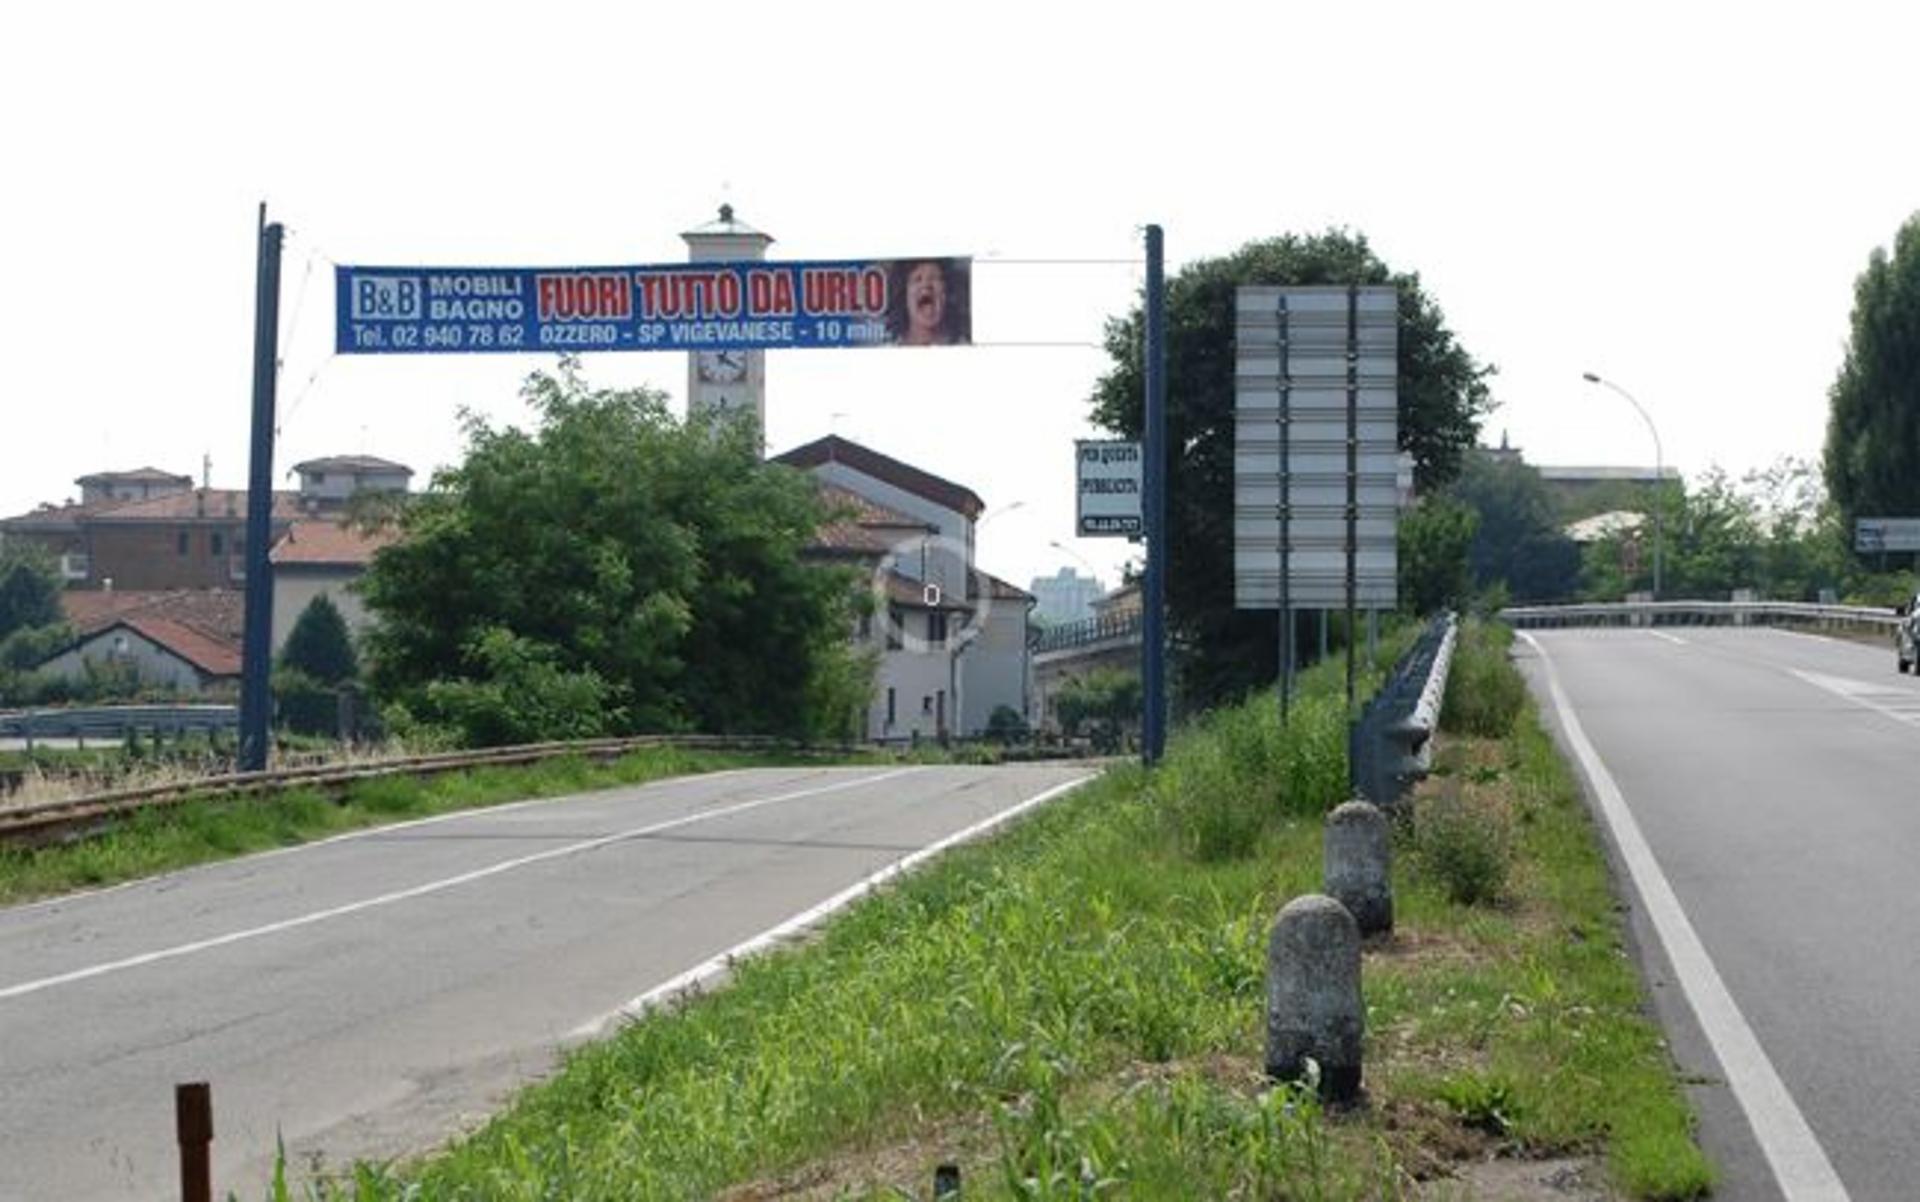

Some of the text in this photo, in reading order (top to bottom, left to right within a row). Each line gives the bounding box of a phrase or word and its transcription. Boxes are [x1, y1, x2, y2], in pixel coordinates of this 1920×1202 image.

[357, 278, 417, 316] B&B
[429, 276, 523, 296] MOBILI
[537, 265, 887, 321] FUORI TUTTO DA URLO
[430, 300, 524, 320] BAGNO
[353, 325, 386, 346] Tel.
[392, 325, 418, 346] 02
[425, 325, 461, 345] 940
[499, 325, 524, 344] 62
[540, 324, 617, 344] OZZERO
[638, 322, 665, 344] SP
[671, 321, 793, 342] VIGEVANESE
[815, 319, 840, 341] 10
